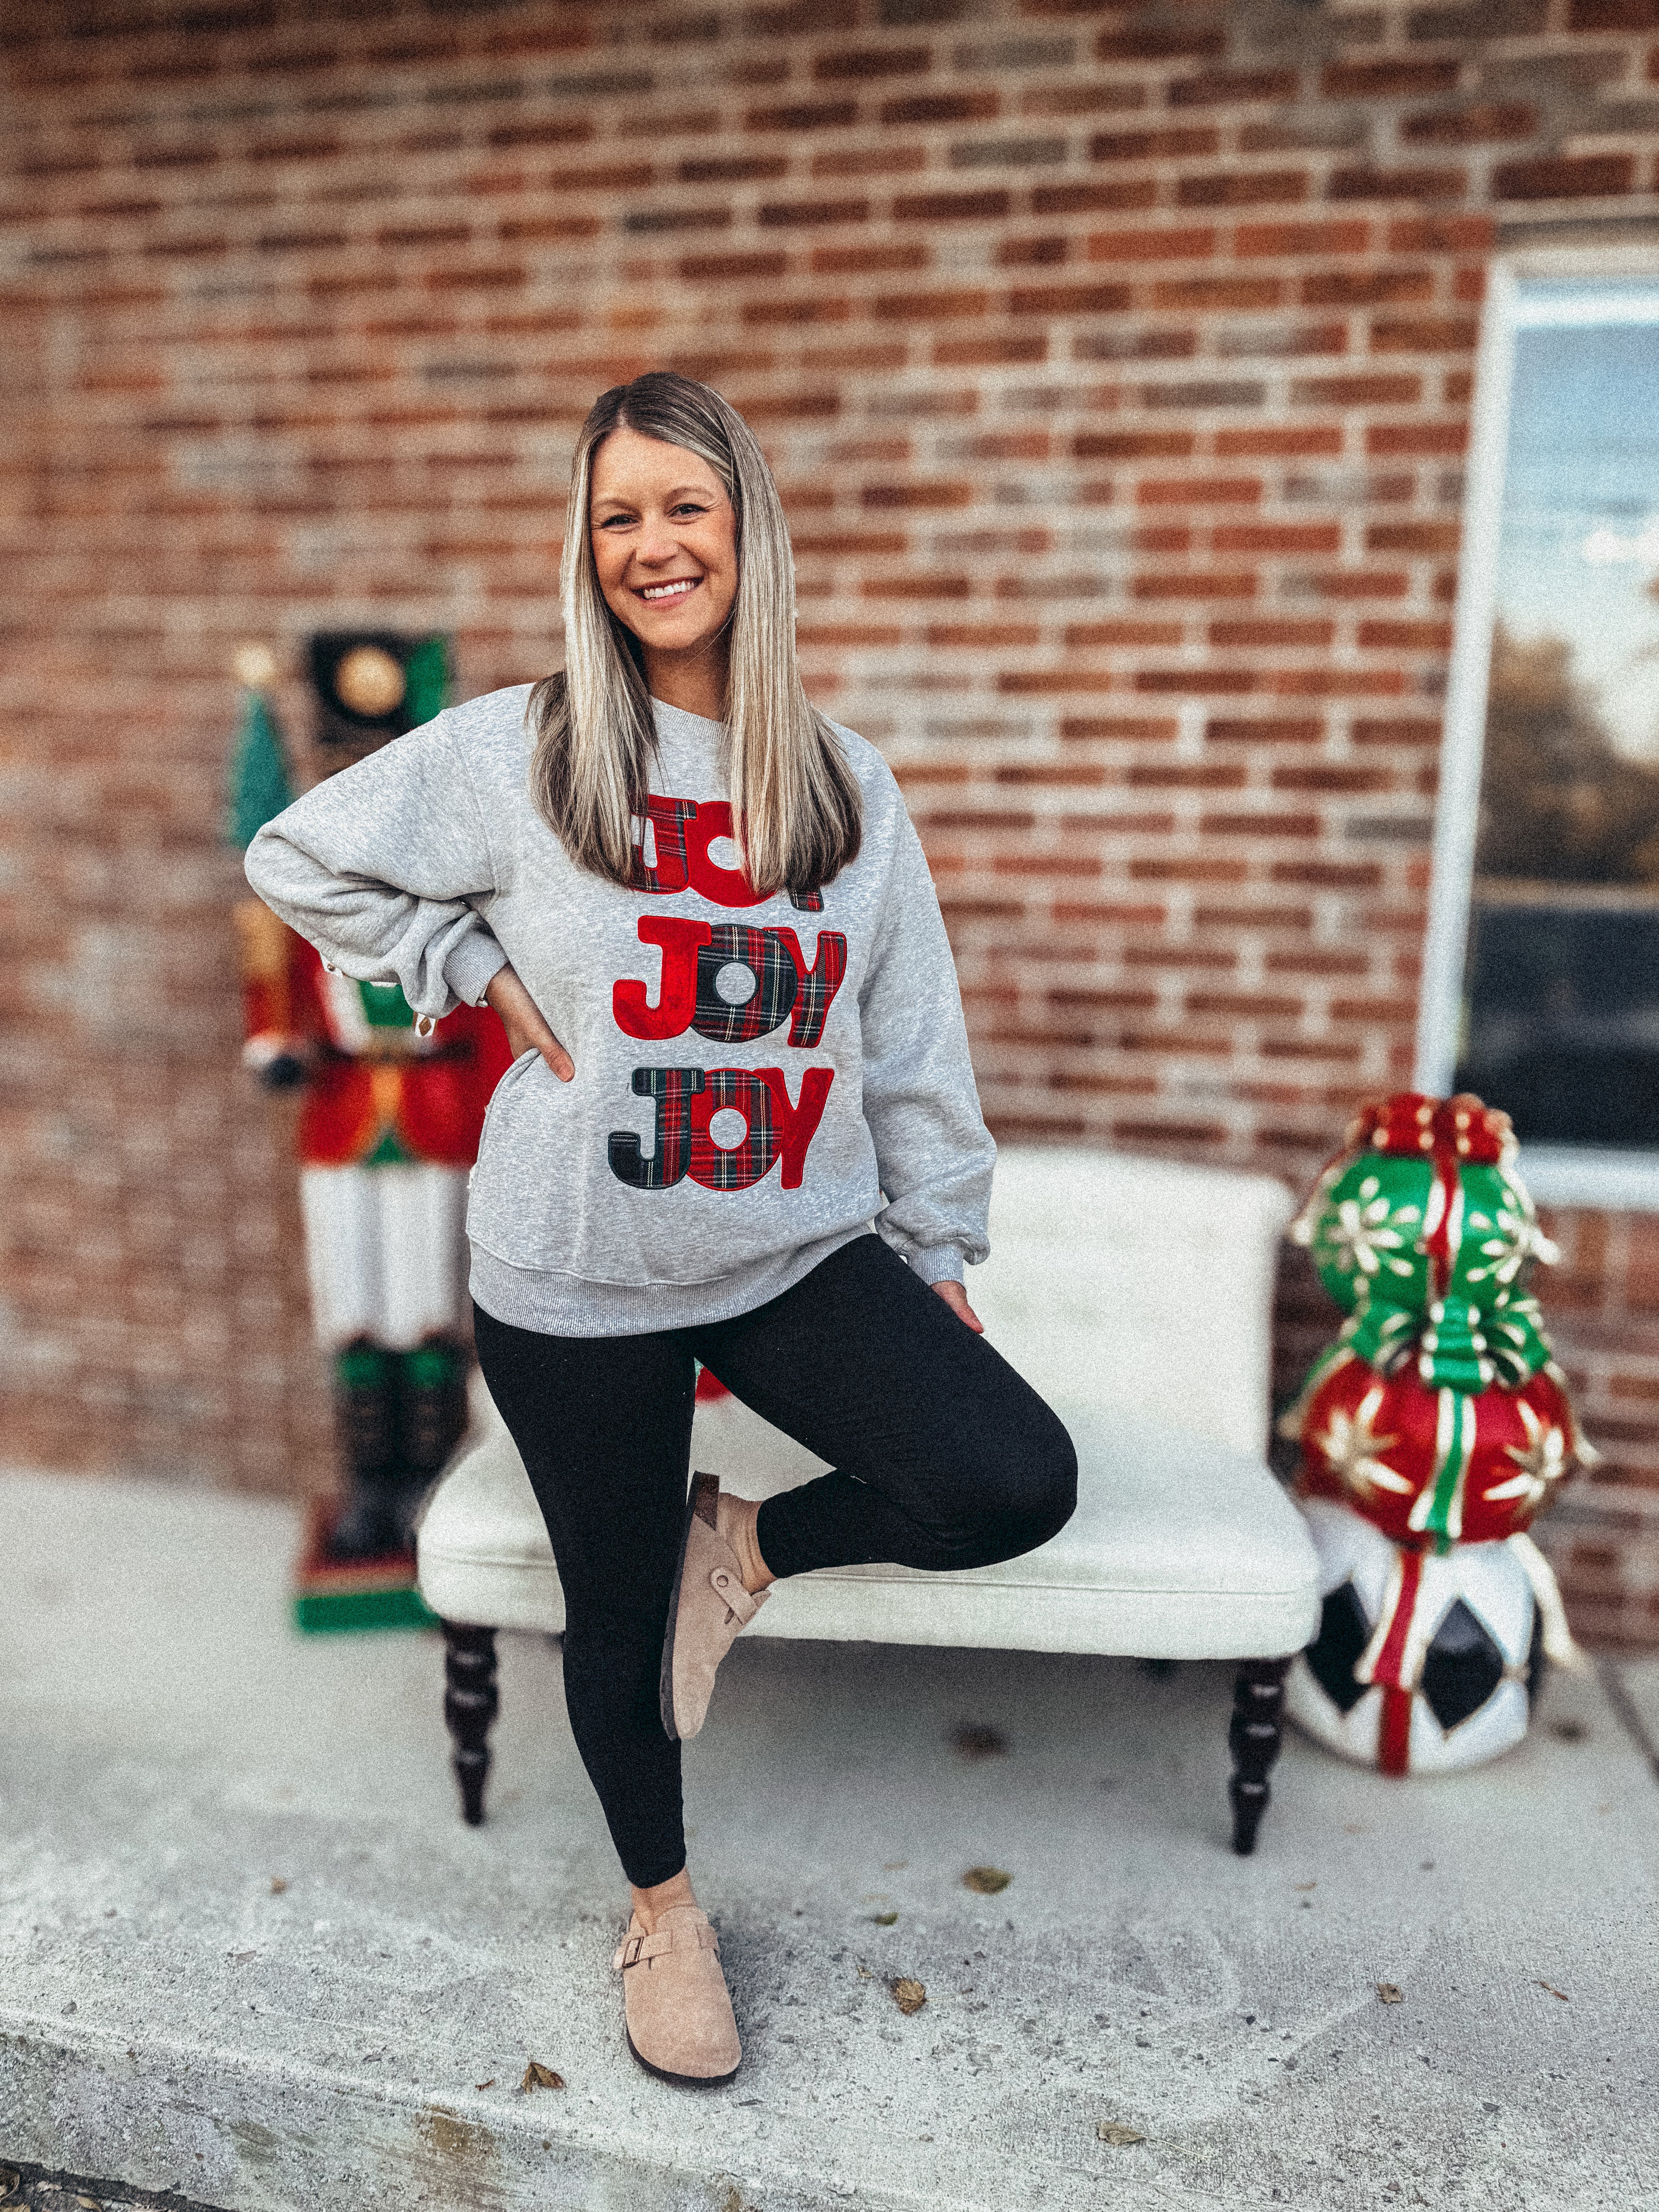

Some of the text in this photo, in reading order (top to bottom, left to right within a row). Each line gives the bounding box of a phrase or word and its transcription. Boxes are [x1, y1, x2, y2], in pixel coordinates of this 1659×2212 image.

[630, 794, 824, 912] JO
[612, 915, 847, 1048] JOY
[607, 1067, 835, 1192] JOY
